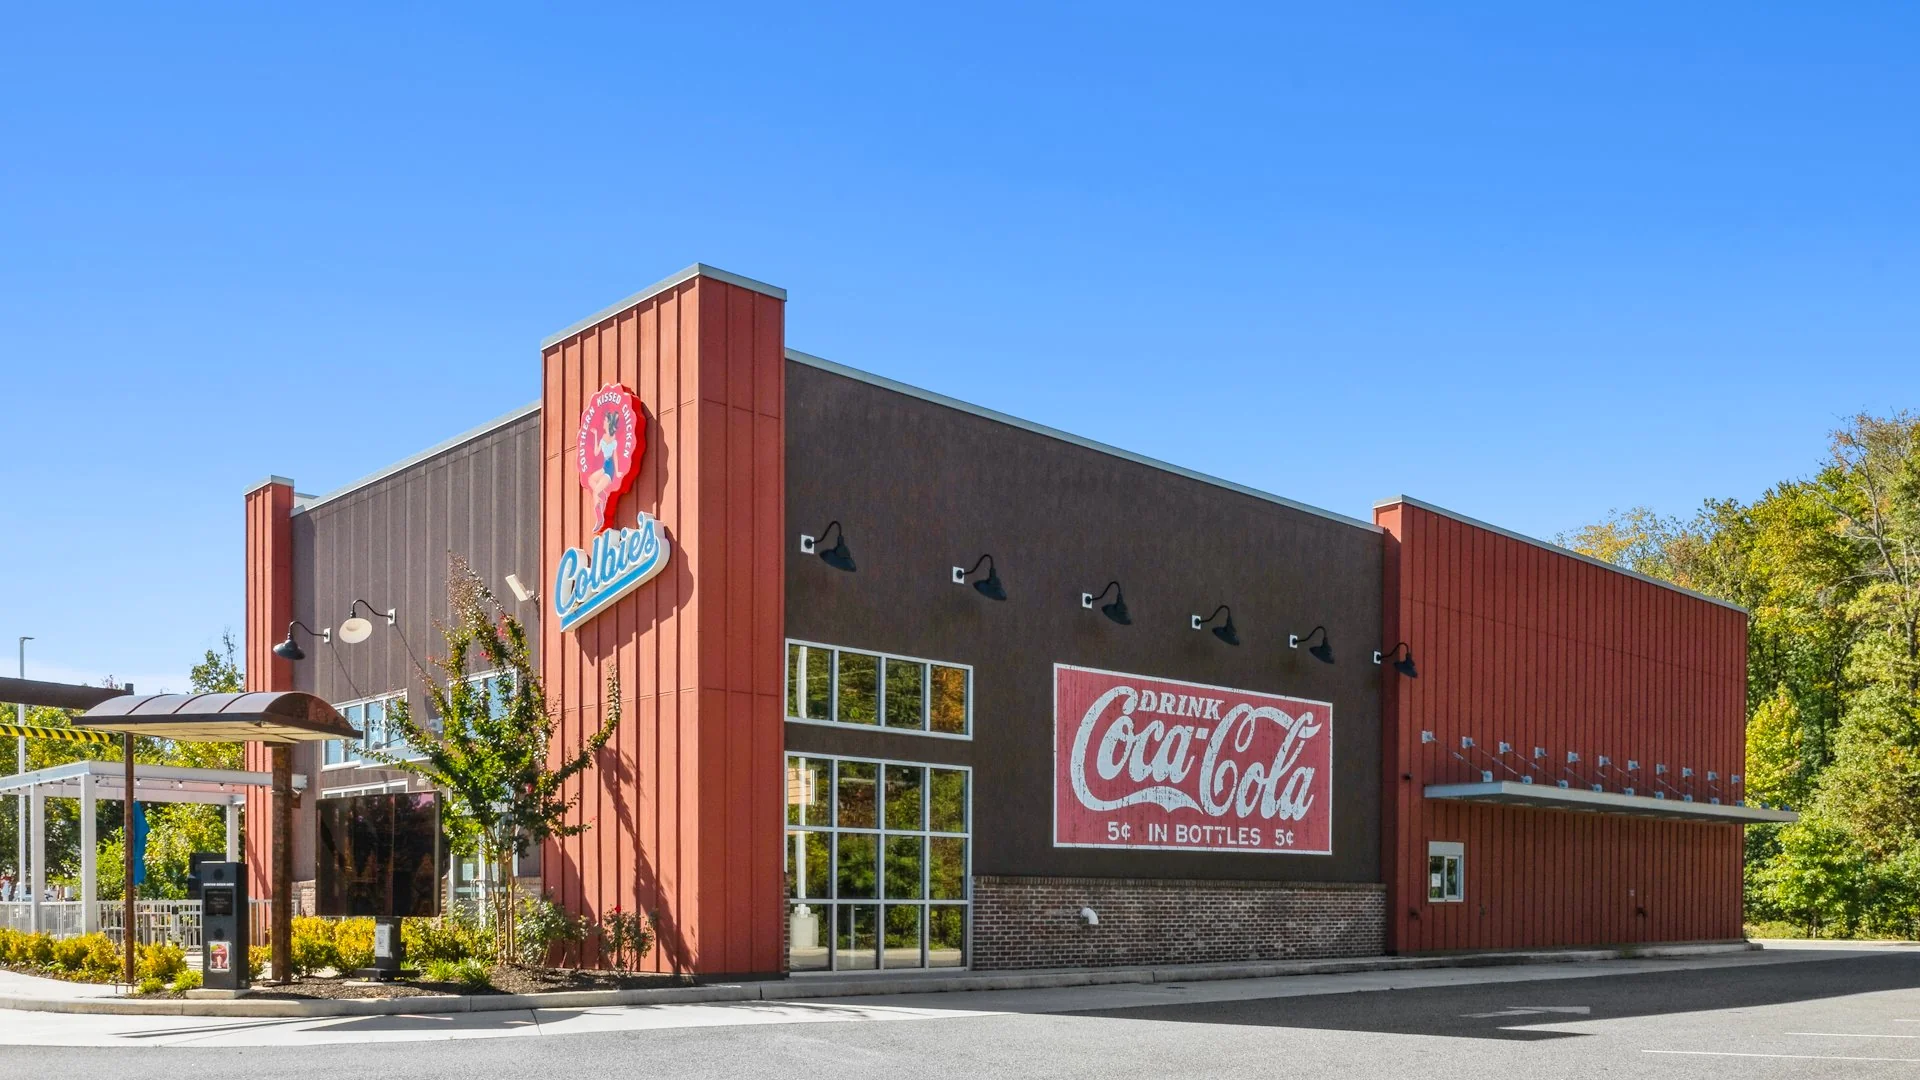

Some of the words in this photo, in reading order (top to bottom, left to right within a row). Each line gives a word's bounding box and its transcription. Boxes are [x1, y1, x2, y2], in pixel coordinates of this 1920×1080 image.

[579, 406, 595, 473] SOUTHERN
[596, 391, 622, 407] KISSED
[621, 404, 633, 459] CHICKEN
[555, 512, 660, 618] Colbie's
[1137, 689, 1225, 721] DRINK
[1070, 685, 1322, 821] Coca-Cola
[1107, 821, 1131, 842] 5¢
[1148, 822, 1168, 843] IN
[1175, 824, 1261, 846] BOTTLES
[1275, 828, 1294, 847] 5¢
